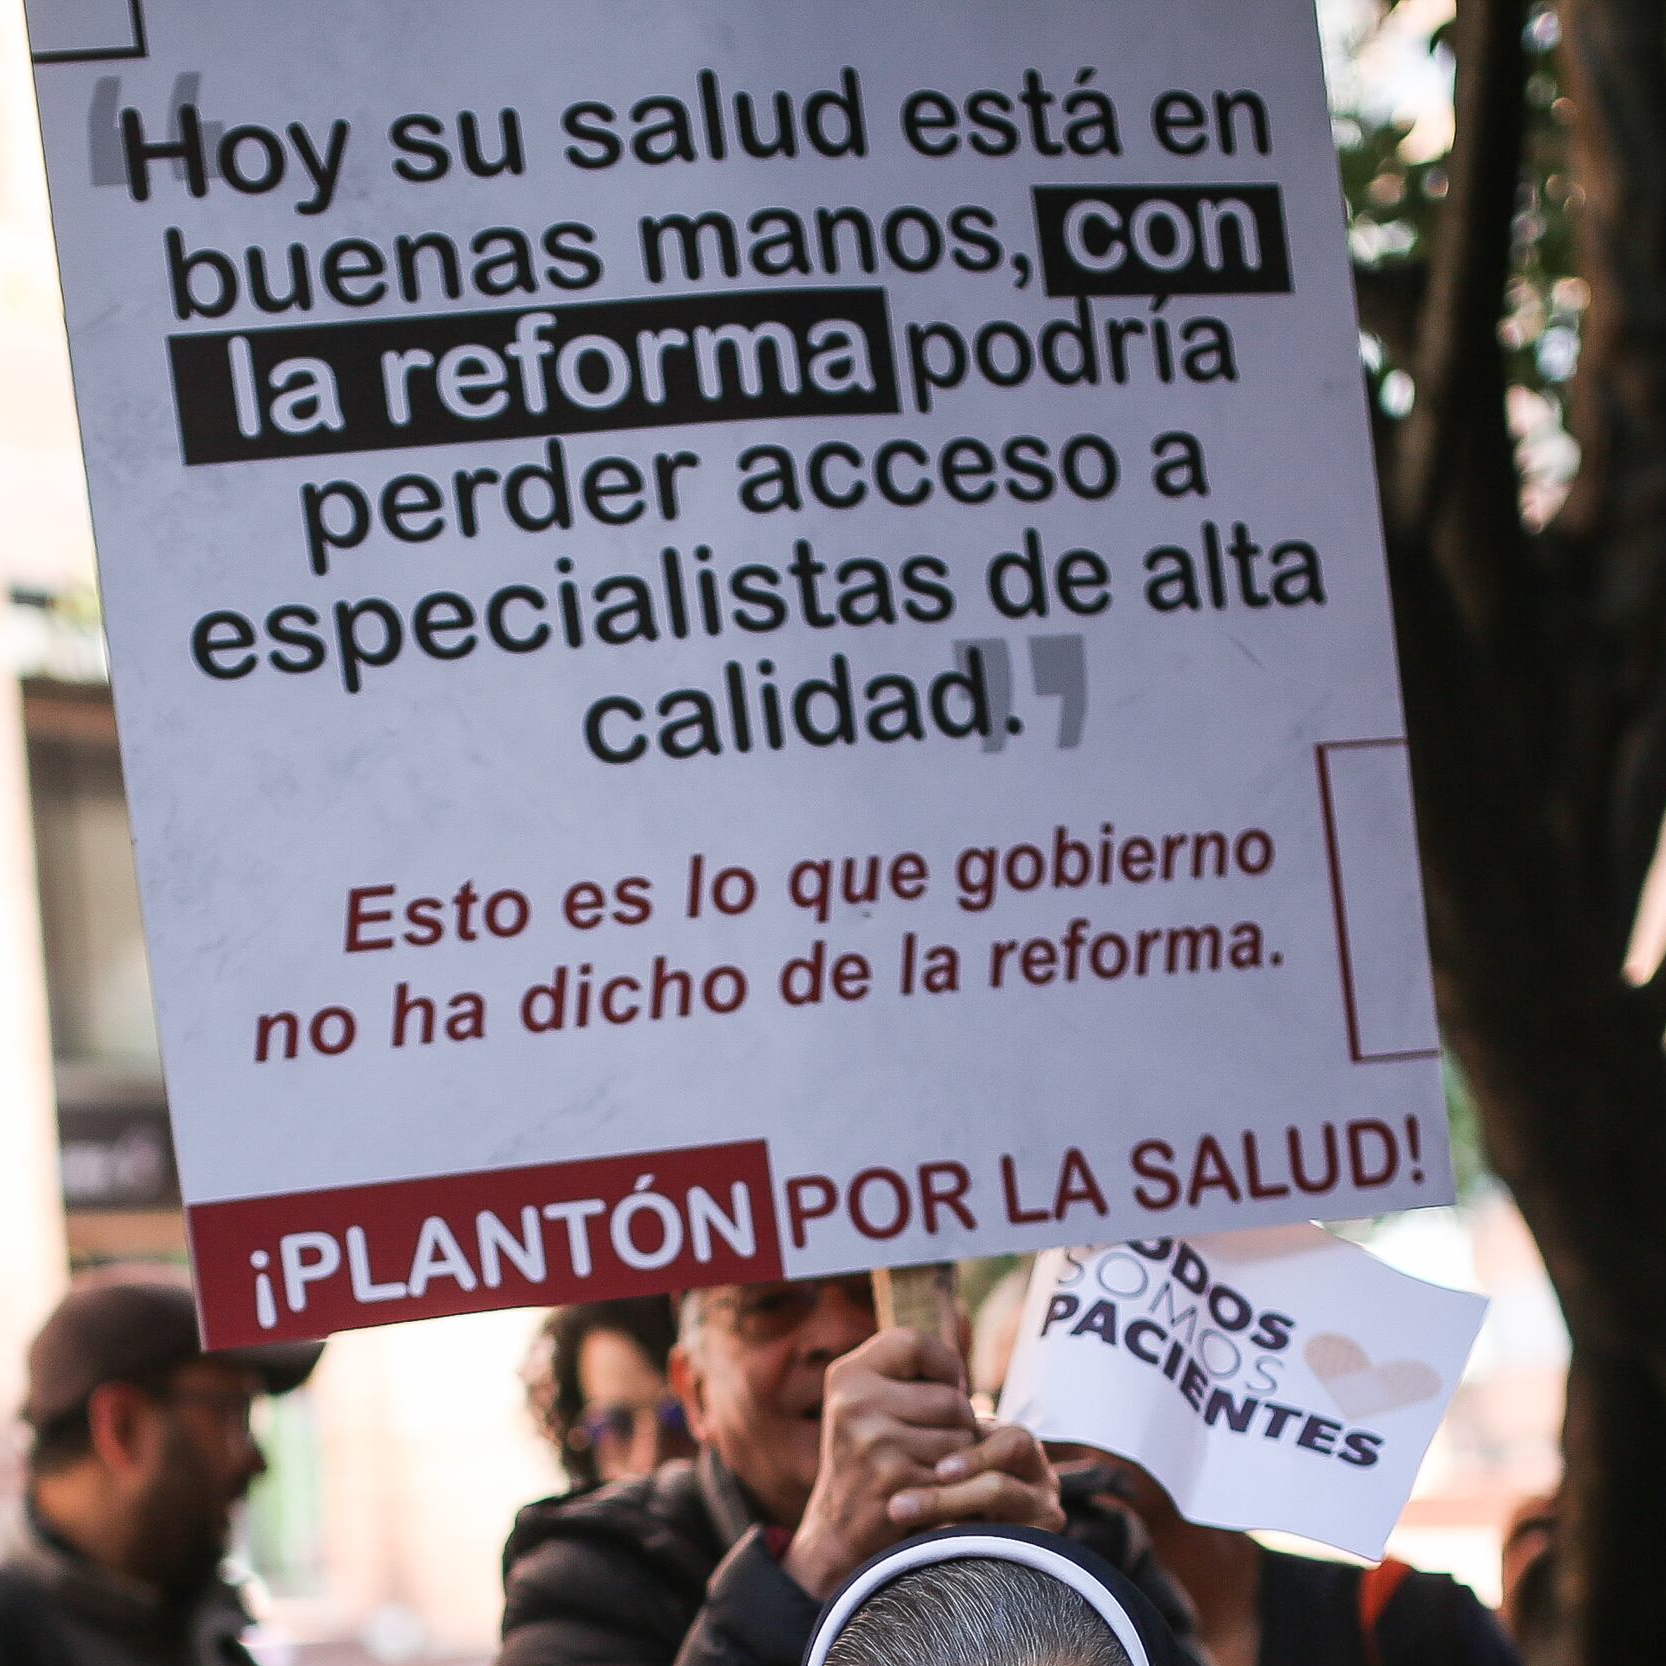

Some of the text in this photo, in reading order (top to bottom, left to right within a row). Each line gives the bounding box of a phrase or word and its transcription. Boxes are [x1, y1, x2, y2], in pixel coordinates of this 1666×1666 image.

[390, 105, 525, 180] su
[562, 65, 868, 163] salud
[899, 65, 1121, 157] está
[1149, 85, 1271, 157] en
[163, 200, 1264, 321] buenas manos, con
[224, 292, 1239, 441] la reforma podría
[300, 431, 1208, 576] perder acceso a
[193, 520, 1329, 694] especialistas de alta
[342, 823, 1275, 955] Esto es lo que gobierno
[252, 916, 1285, 1065] no ha dicho de la reforma.
[248, 1112, 1429, 1329] ¡PLANTÓN POR LA SALUD!
[1039, 1293, 1385, 1468] PACIENTES
[1055, 1246, 1286, 1398] SOMOS
